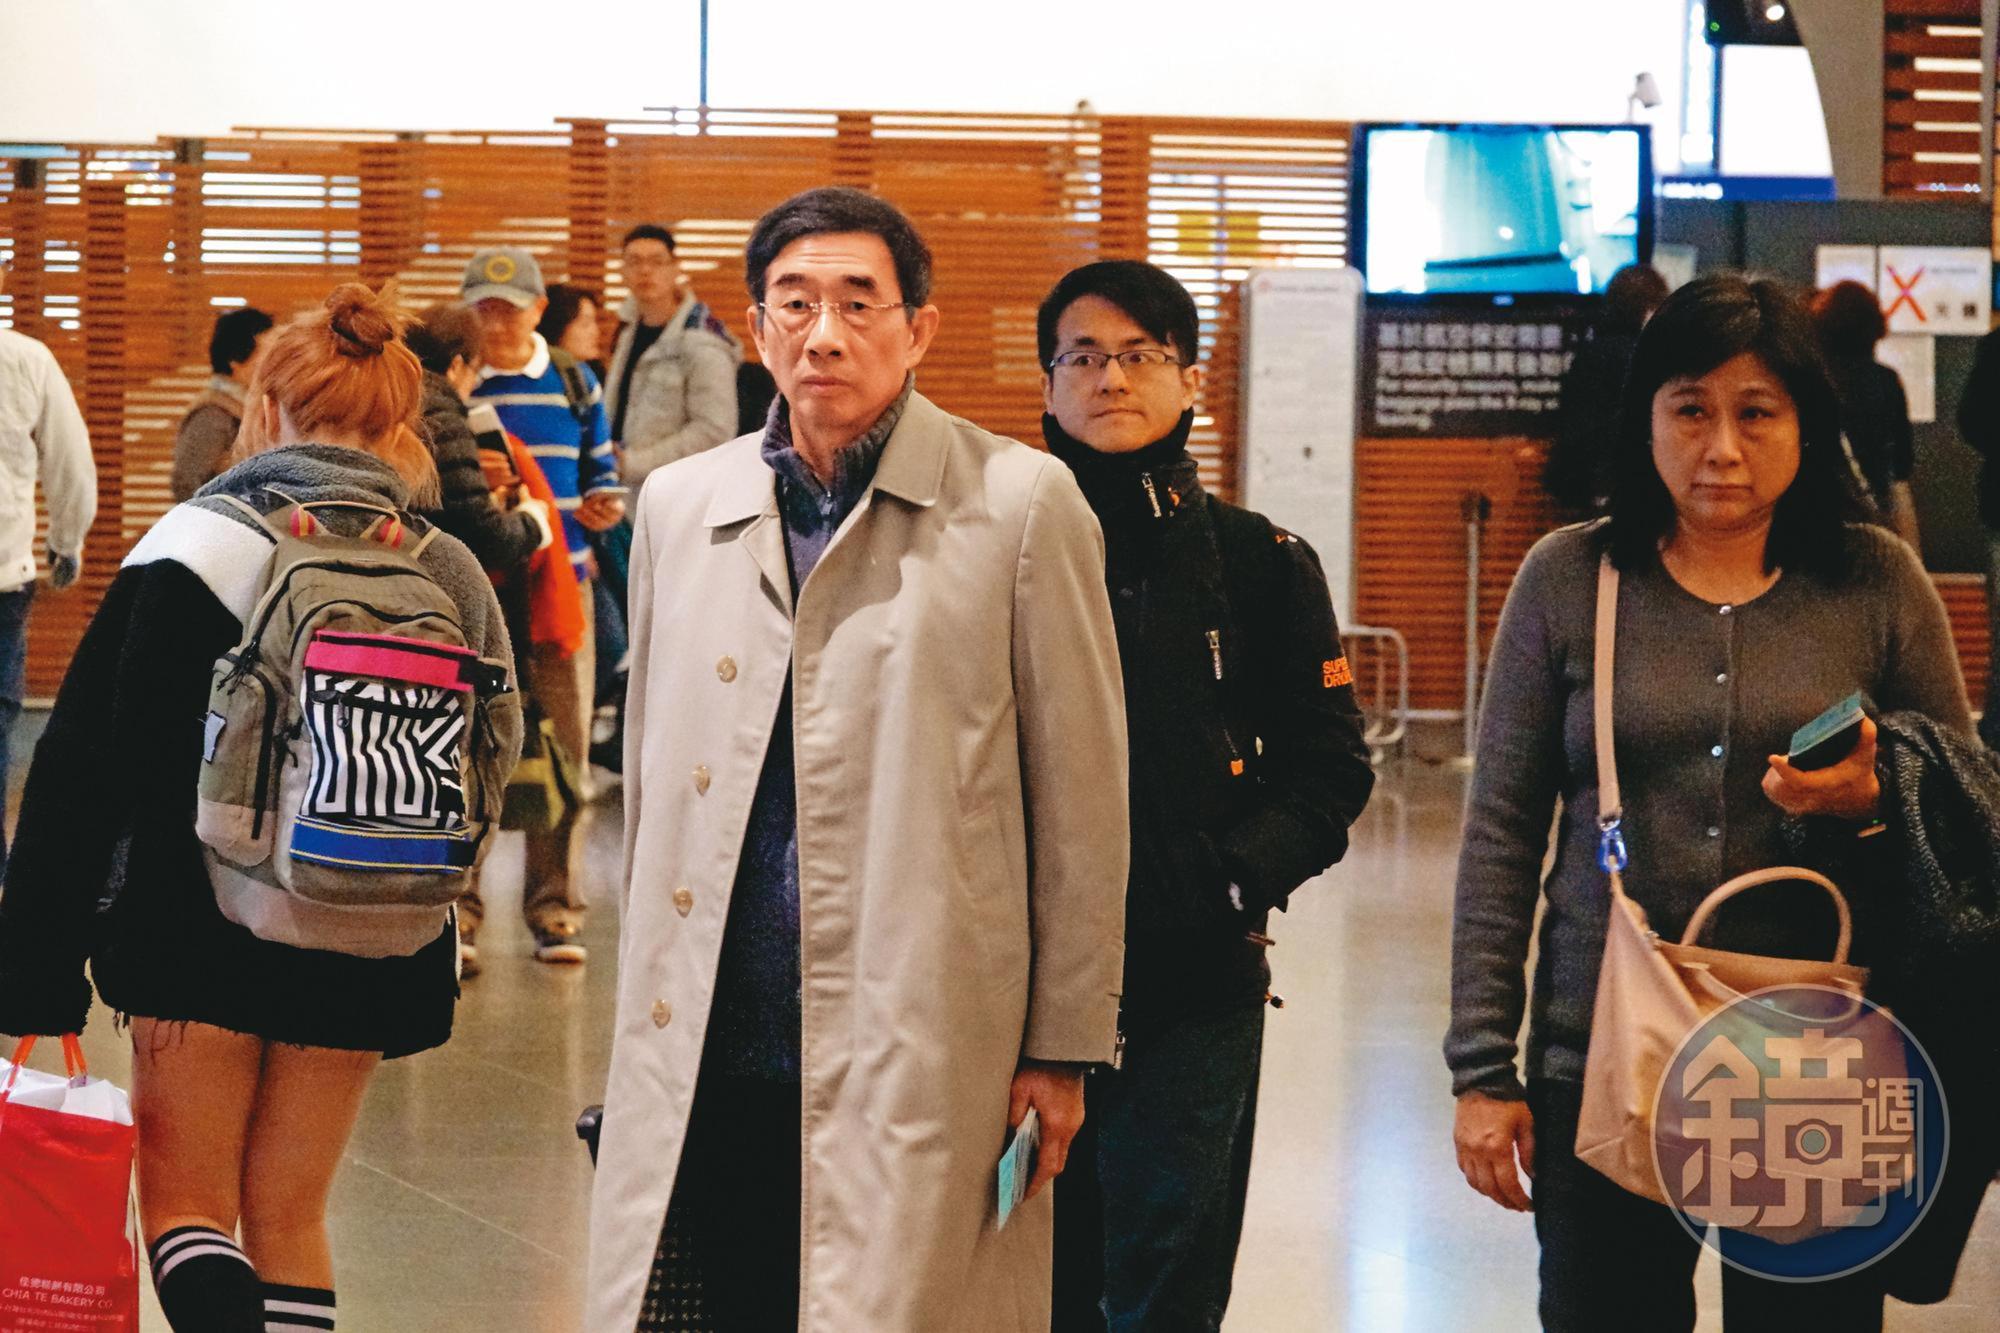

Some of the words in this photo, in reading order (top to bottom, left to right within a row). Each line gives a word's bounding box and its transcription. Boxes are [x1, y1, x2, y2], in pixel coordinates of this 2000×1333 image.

[2, 1287, 30, 1300] CHIA
[34, 1291, 47, 1303] TE
[50, 1294, 95, 1308] BAKERY
